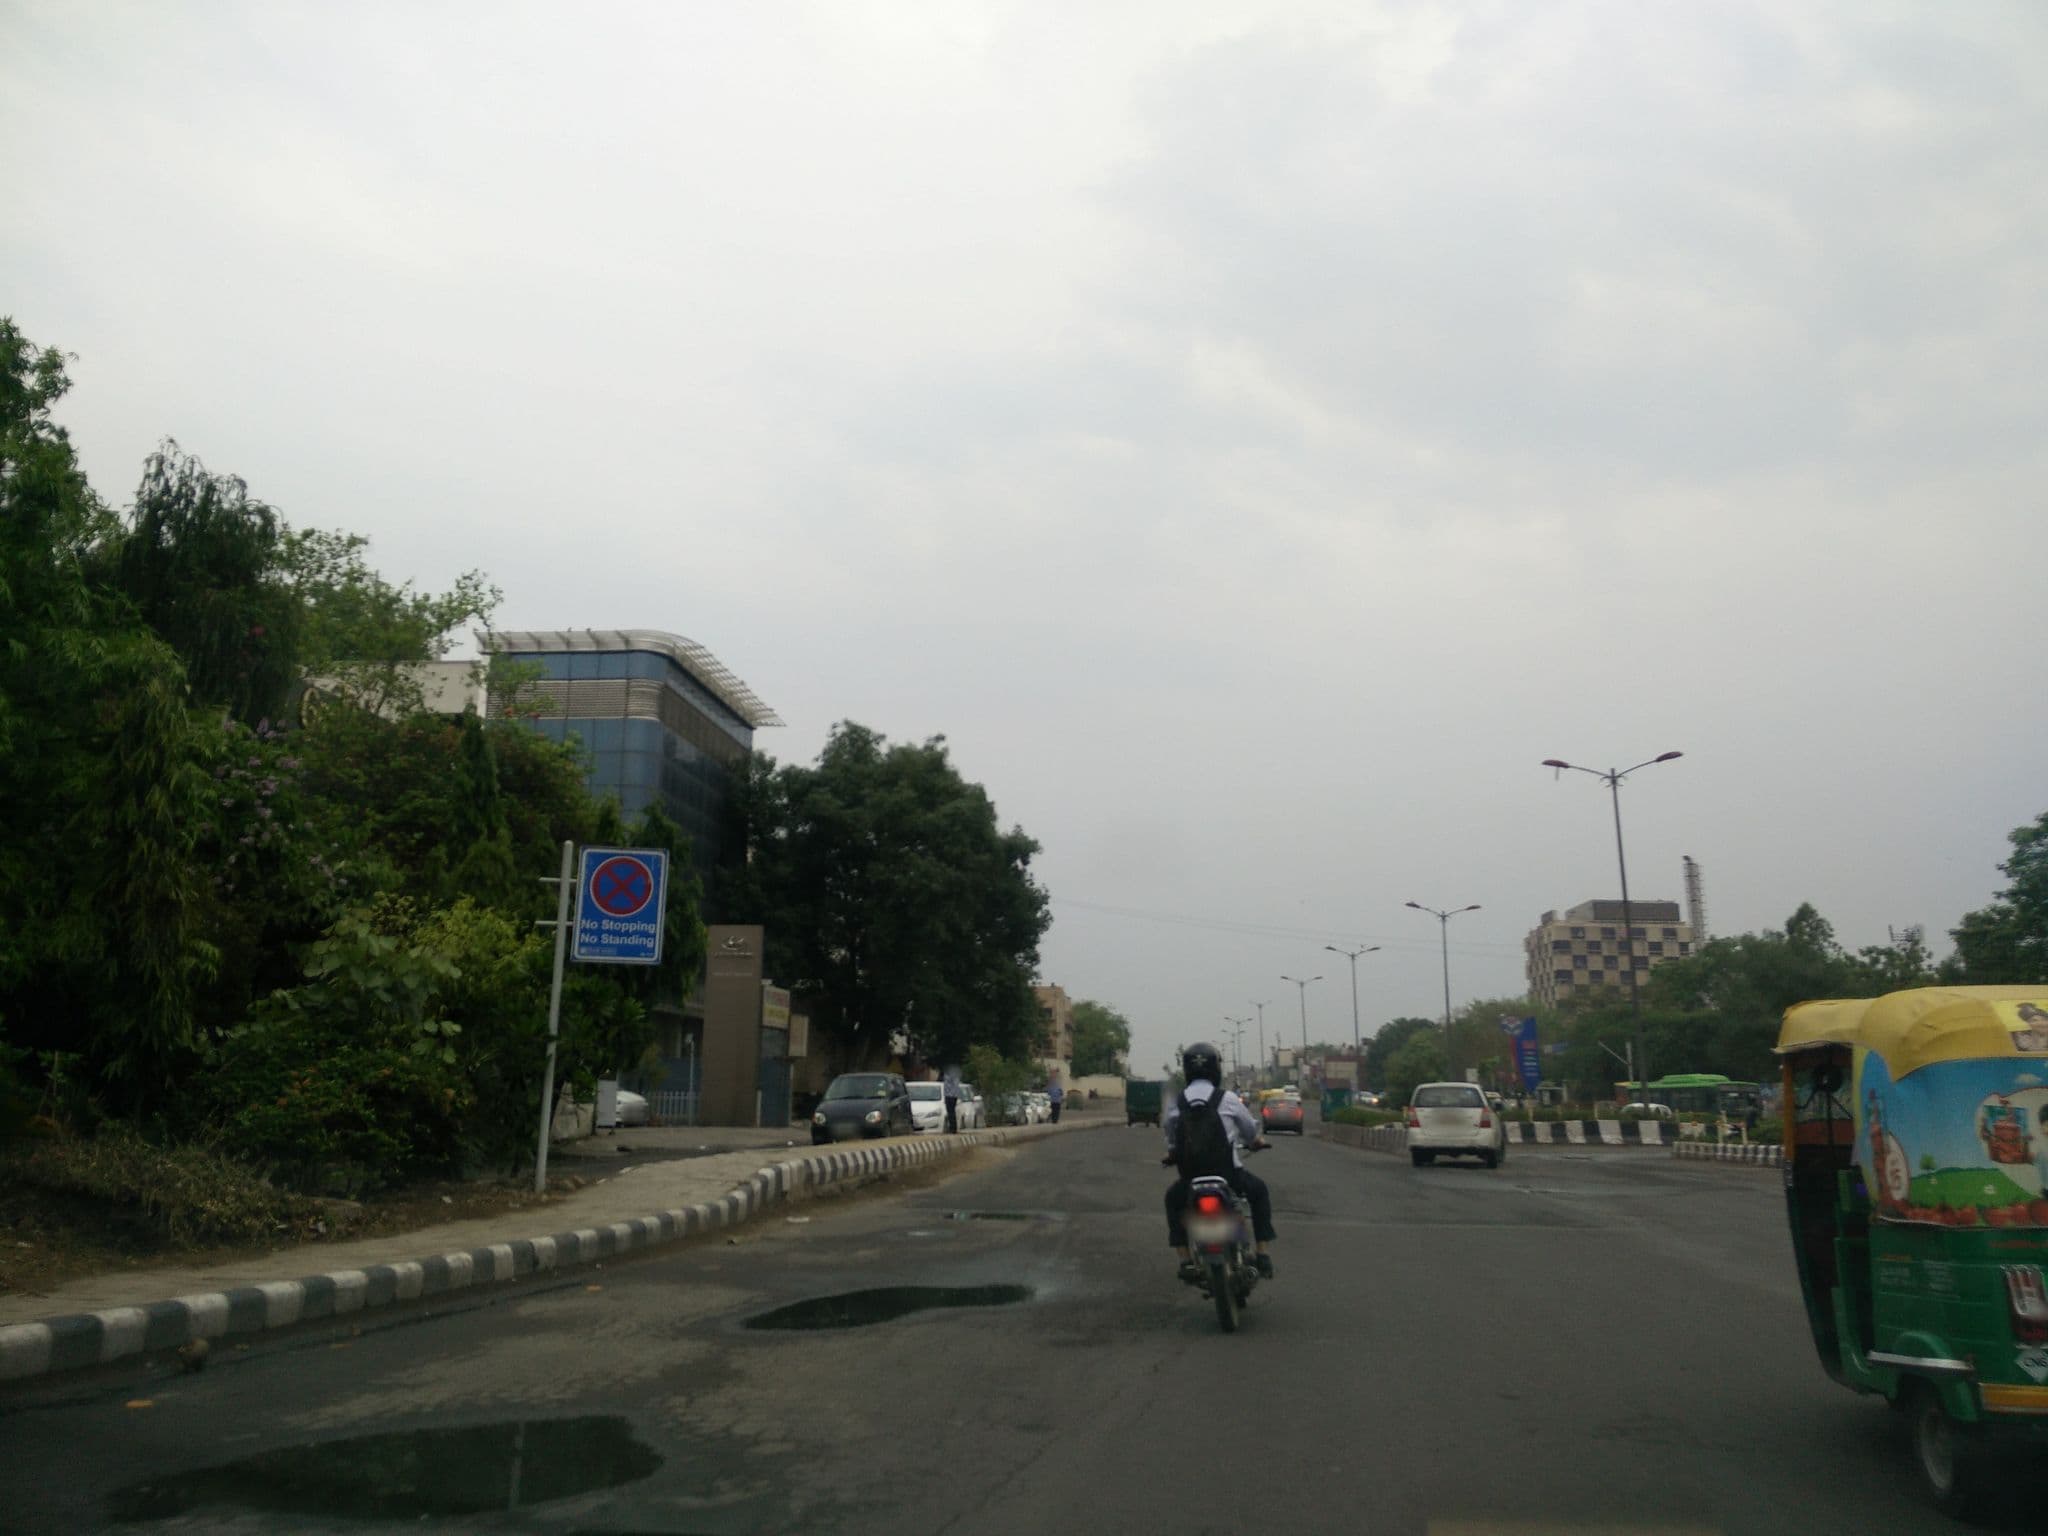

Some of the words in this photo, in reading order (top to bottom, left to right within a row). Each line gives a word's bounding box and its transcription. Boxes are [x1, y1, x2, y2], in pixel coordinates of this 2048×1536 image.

[580, 919, 598, 930] No
[601, 919, 656, 934] Stopping
[580, 933, 598, 944] No
[600, 933, 654, 948] Standing
